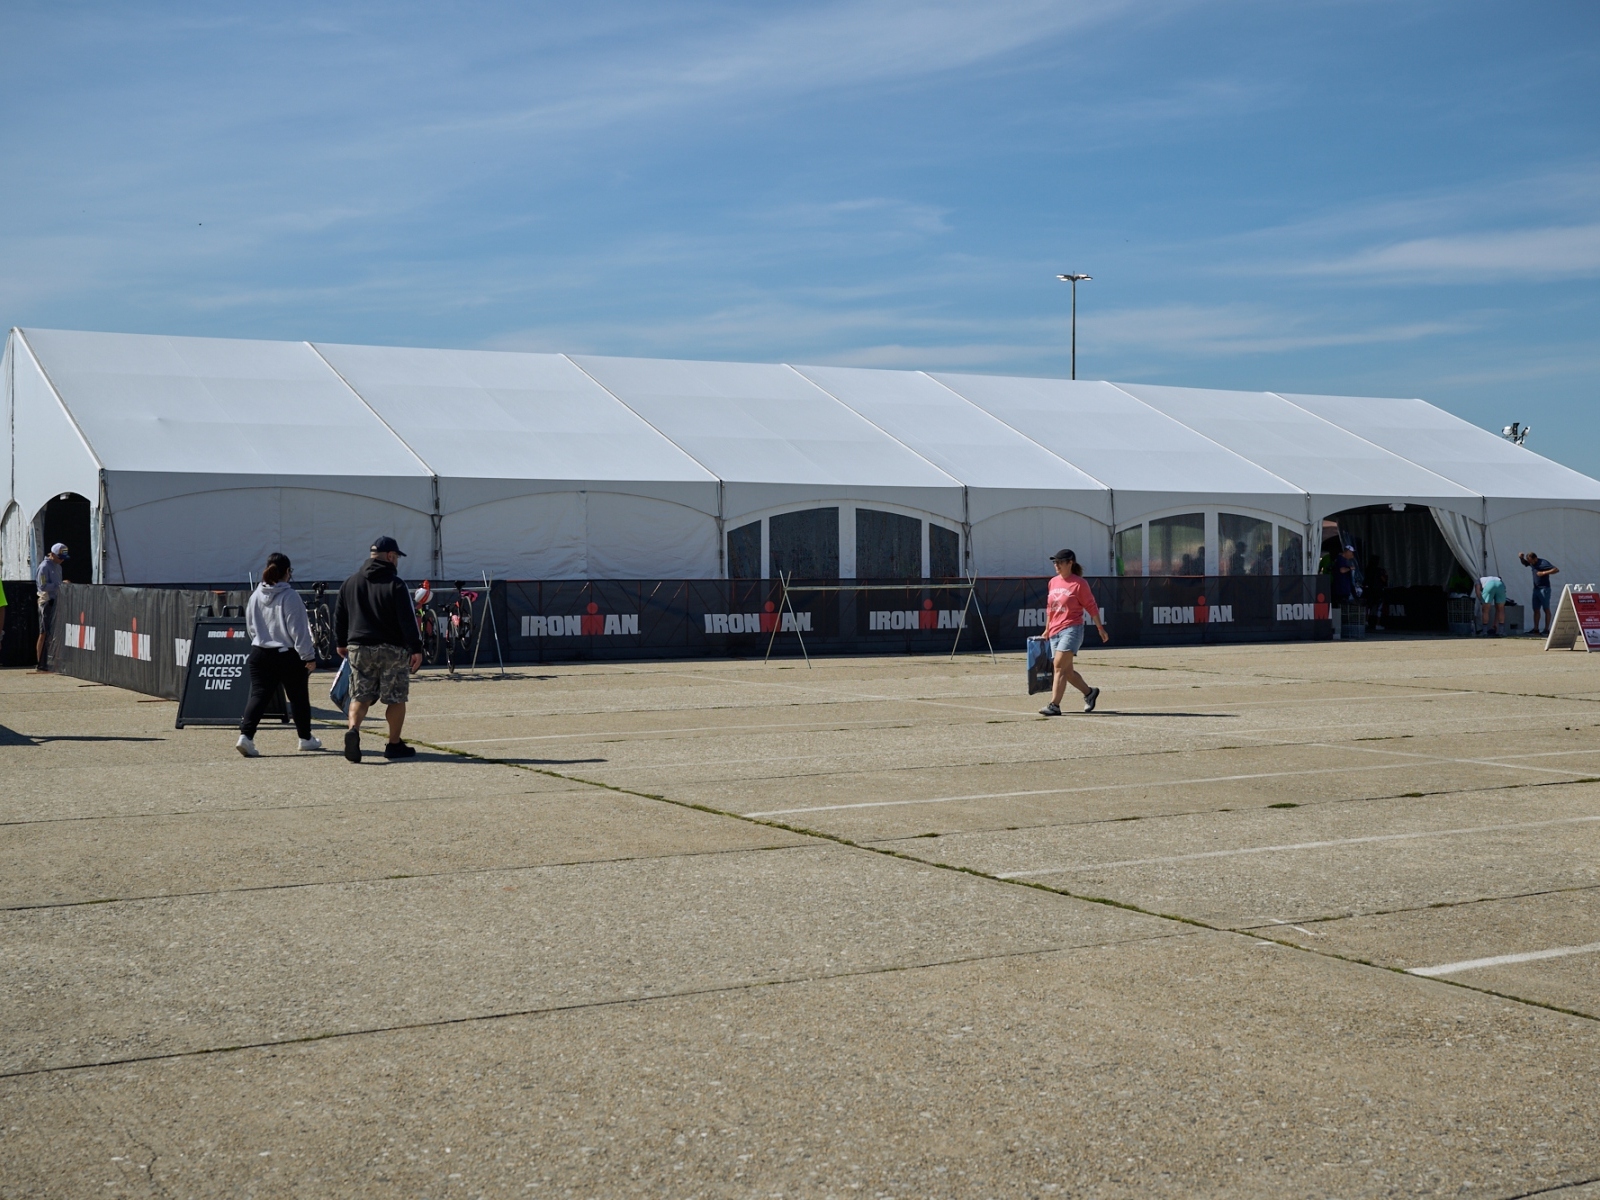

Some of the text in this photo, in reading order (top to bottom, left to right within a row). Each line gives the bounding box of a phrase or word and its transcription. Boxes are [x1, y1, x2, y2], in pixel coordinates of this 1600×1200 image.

[521, 602, 642, 637] IRONMAN
[704, 600, 813, 634] IRONMAN
[869, 598, 968, 630] IRONMAN
[1152, 595, 1235, 625] IRONMAN
[64, 611, 96, 651] IRONMAN
[114, 616, 152, 662] IRONMAN
[207, 627, 246, 638] IRONMAN
[196, 653, 250, 665] PRIORITY
[198, 666, 243, 678] ACCESS
[204, 679, 232, 691] LINE
